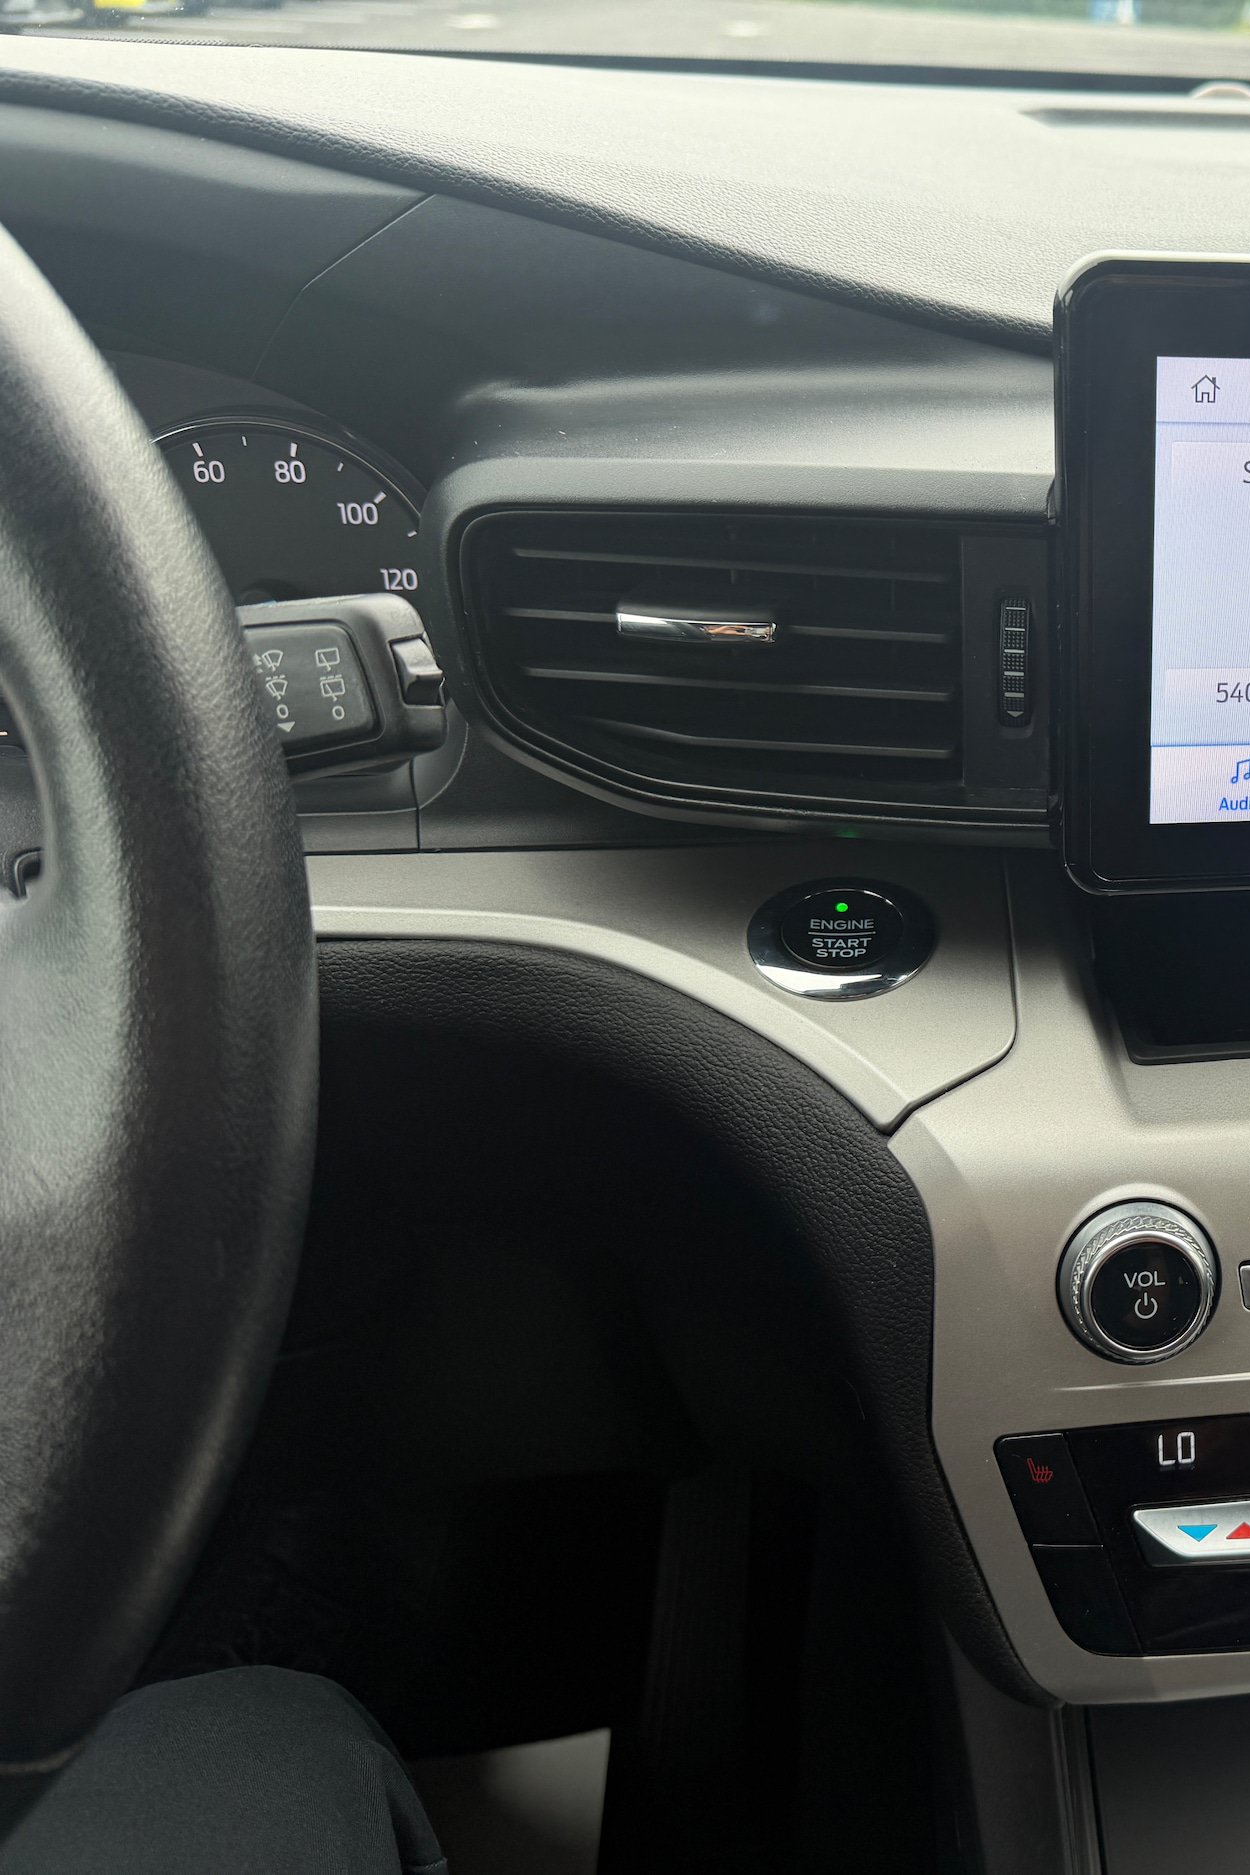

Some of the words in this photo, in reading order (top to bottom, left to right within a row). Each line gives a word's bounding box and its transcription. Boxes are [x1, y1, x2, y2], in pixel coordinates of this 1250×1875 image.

[193, 460, 225, 483] 60
[274, 460, 306, 484] 80
[336, 502, 379, 525] 100
[380, 568, 418, 591] 120
[810, 918, 874, 931] ENGINE
[811, 937, 872, 948] START
[816, 948, 867, 958] STOP
[1123, 1270, 1166, 1289] VOL
